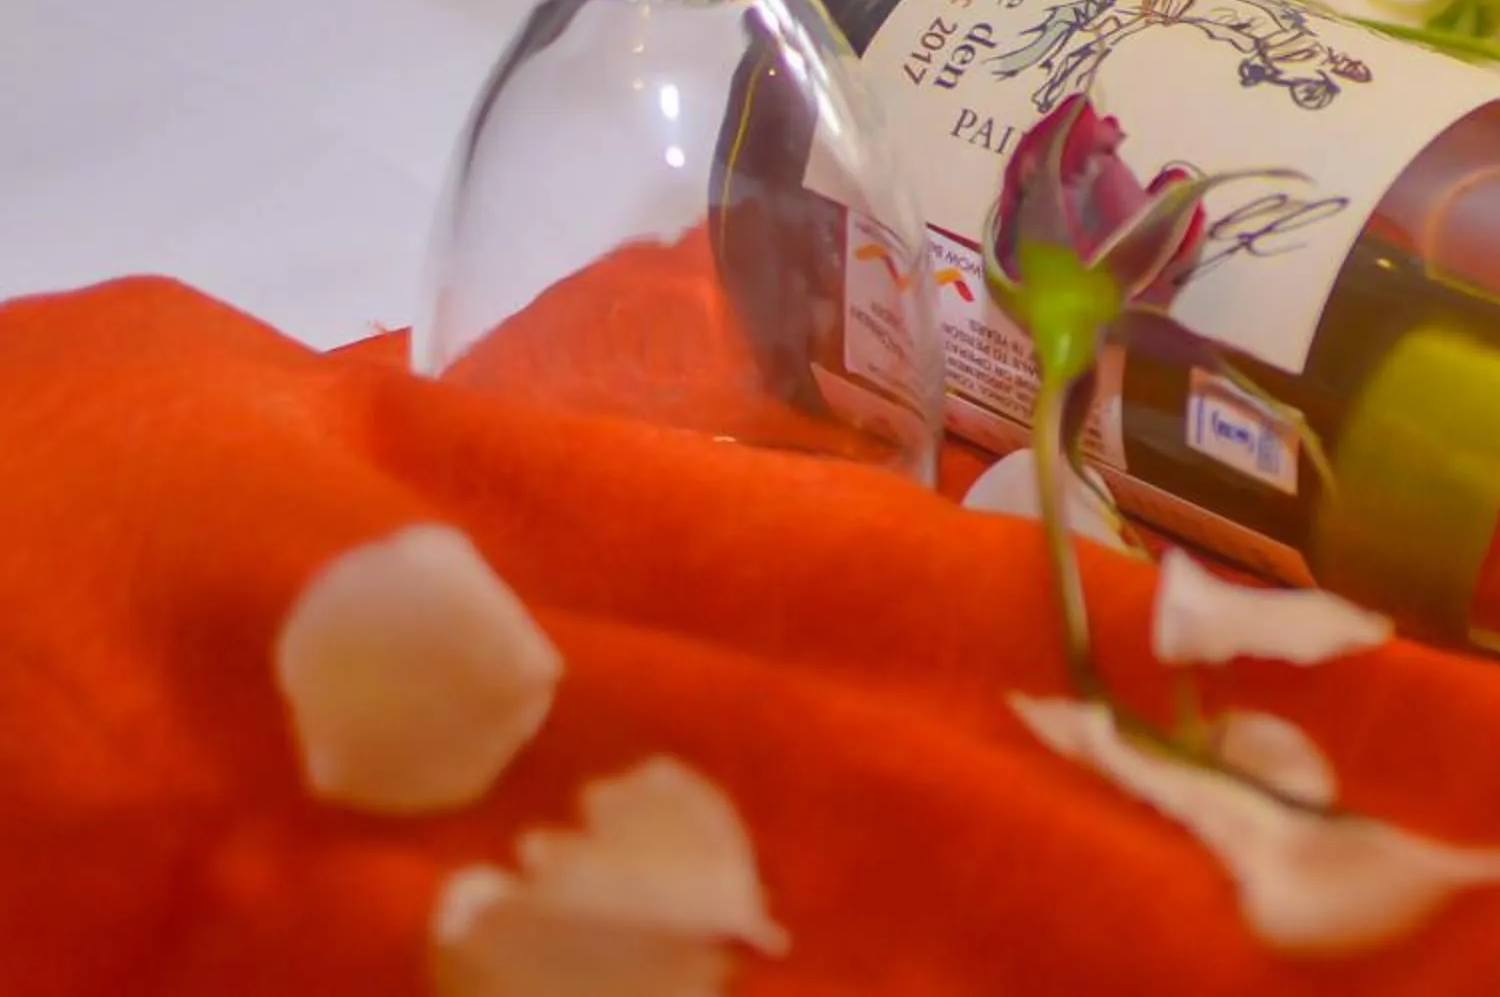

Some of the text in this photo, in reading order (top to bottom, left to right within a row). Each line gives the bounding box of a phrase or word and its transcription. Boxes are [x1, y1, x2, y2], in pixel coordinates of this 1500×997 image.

[903, 17, 958, 85] 2017
[933, 22, 997, 90] den
[951, 108, 1015, 154] PAI
